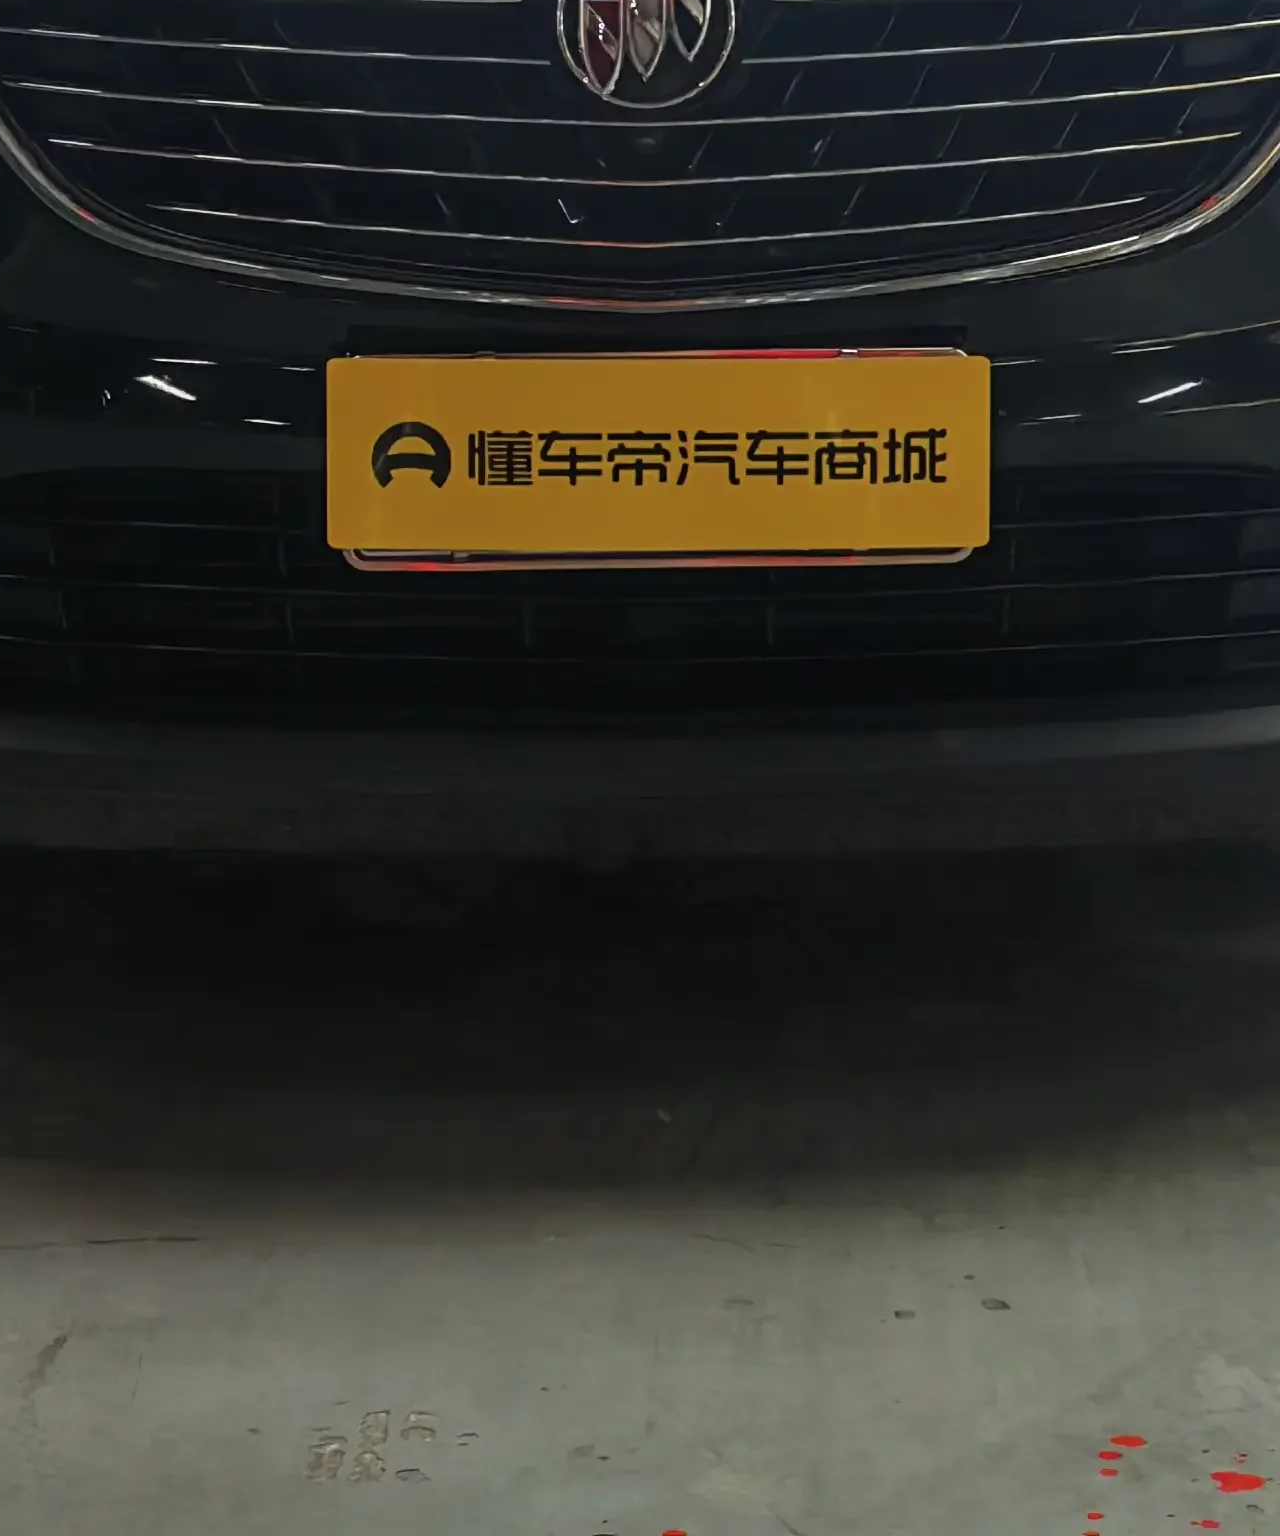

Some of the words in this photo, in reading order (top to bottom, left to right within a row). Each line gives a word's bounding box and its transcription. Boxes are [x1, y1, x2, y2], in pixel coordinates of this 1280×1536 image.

[468, 428, 947, 486] 懂车帝汽车商城
